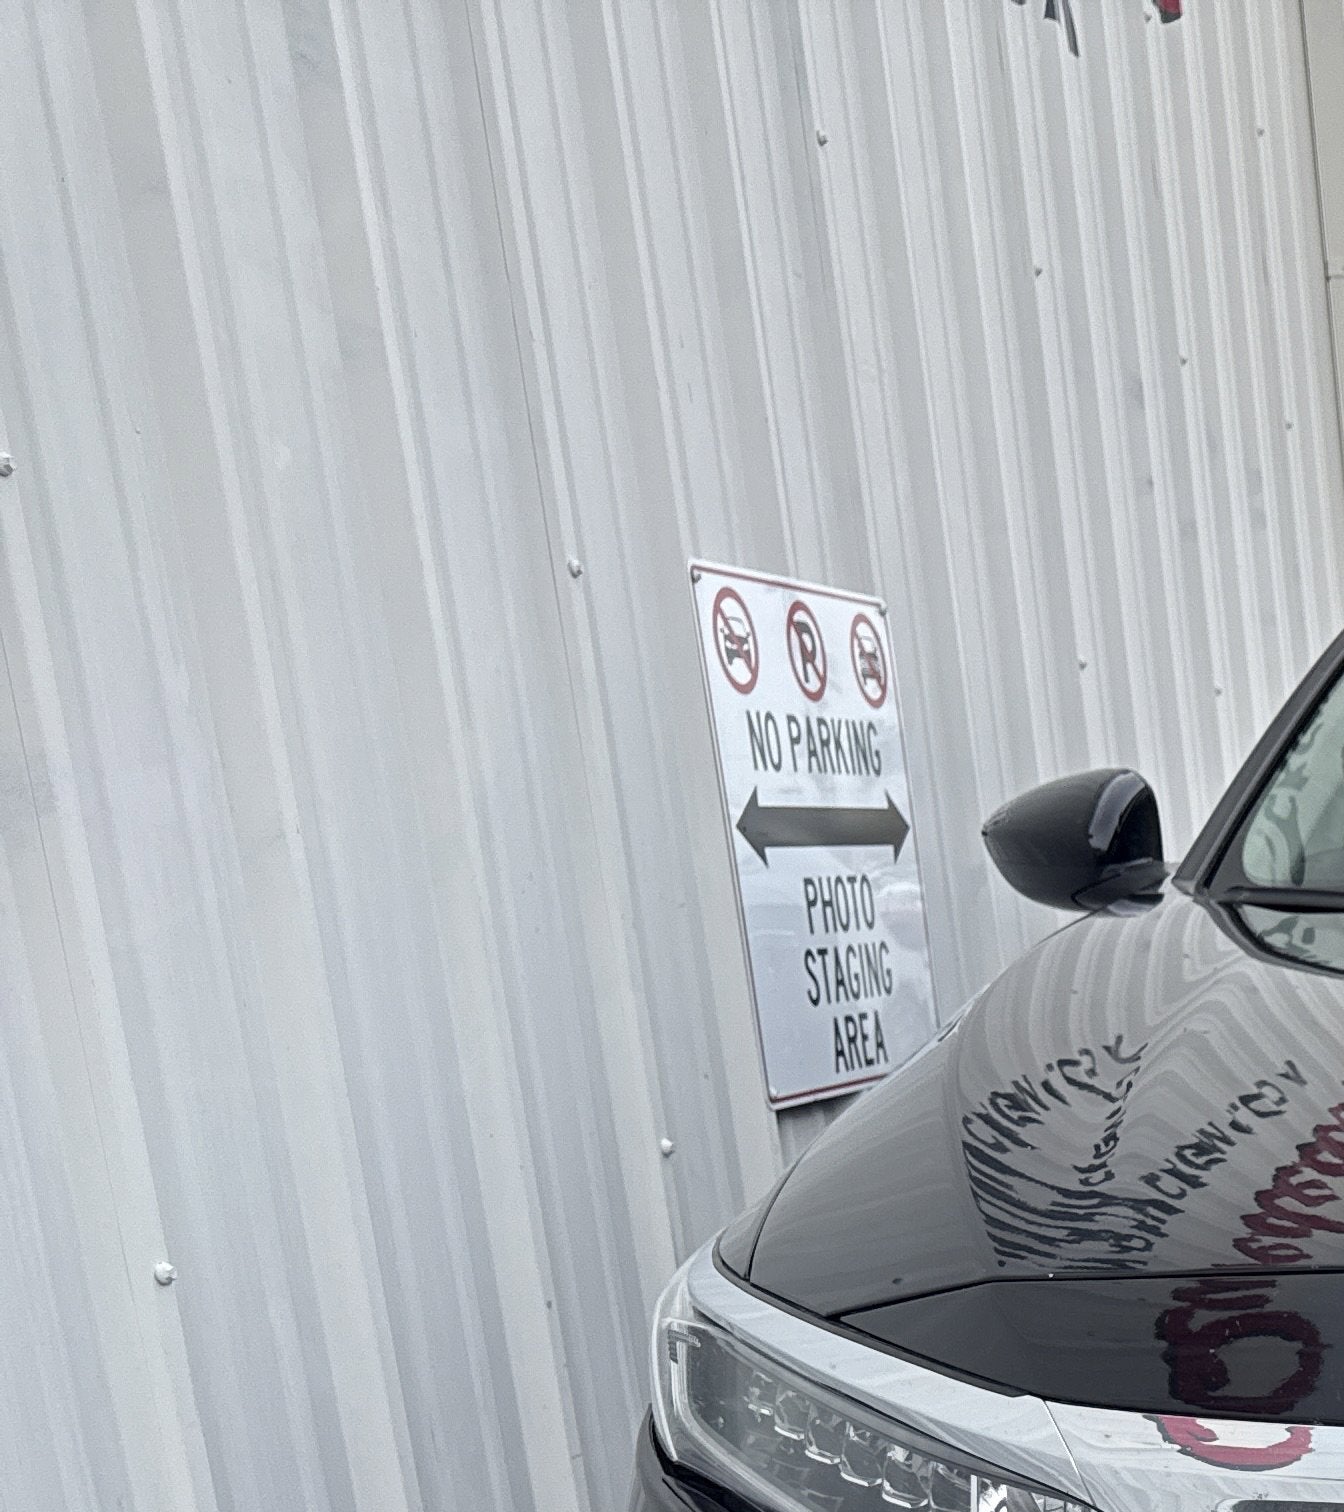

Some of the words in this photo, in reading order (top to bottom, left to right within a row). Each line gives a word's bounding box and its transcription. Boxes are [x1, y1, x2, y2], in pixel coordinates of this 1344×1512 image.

[746, 709, 782, 772] NO
[786, 713, 882, 777] PARKING
[803, 873, 875, 935] PHOTO
[804, 940, 893, 1007] STAGING
[833, 1009, 890, 1074] AREA
